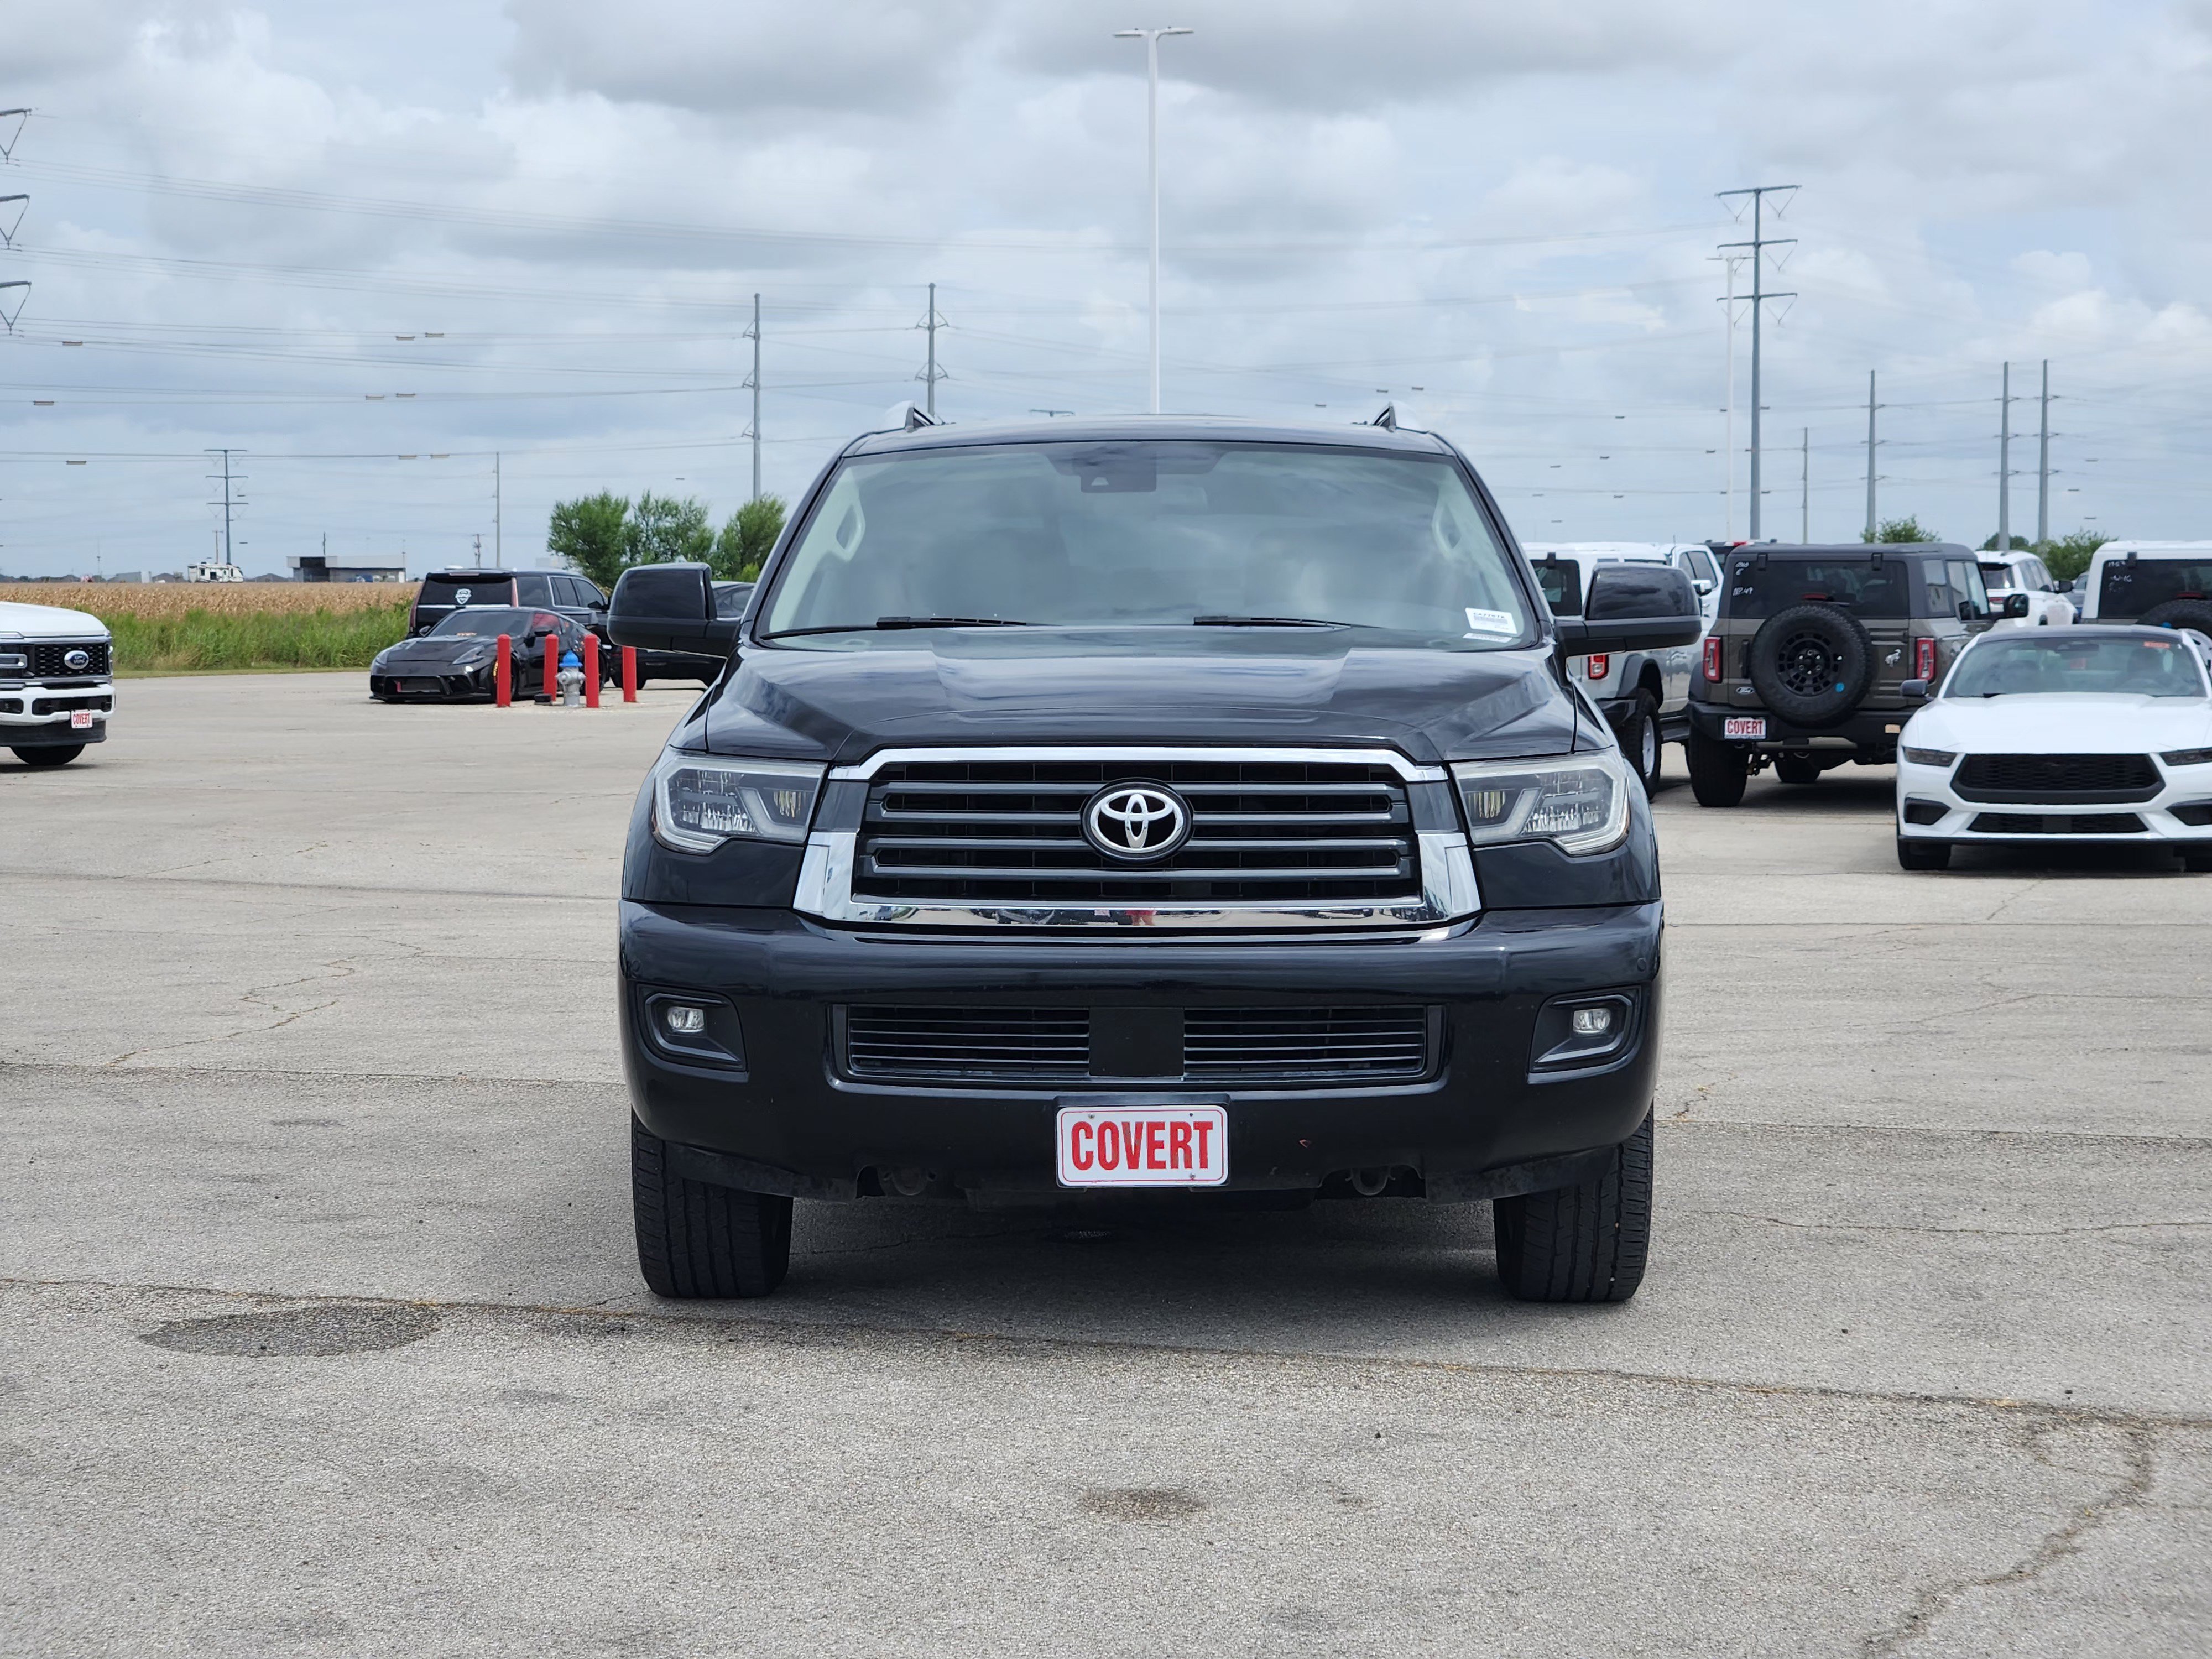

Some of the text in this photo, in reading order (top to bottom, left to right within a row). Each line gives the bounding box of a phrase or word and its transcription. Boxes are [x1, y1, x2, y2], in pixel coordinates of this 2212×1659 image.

[73, 713, 90, 725] COVERT
[1728, 721, 1762, 734] COVERT
[1071, 1121, 1213, 1171] COVERT
